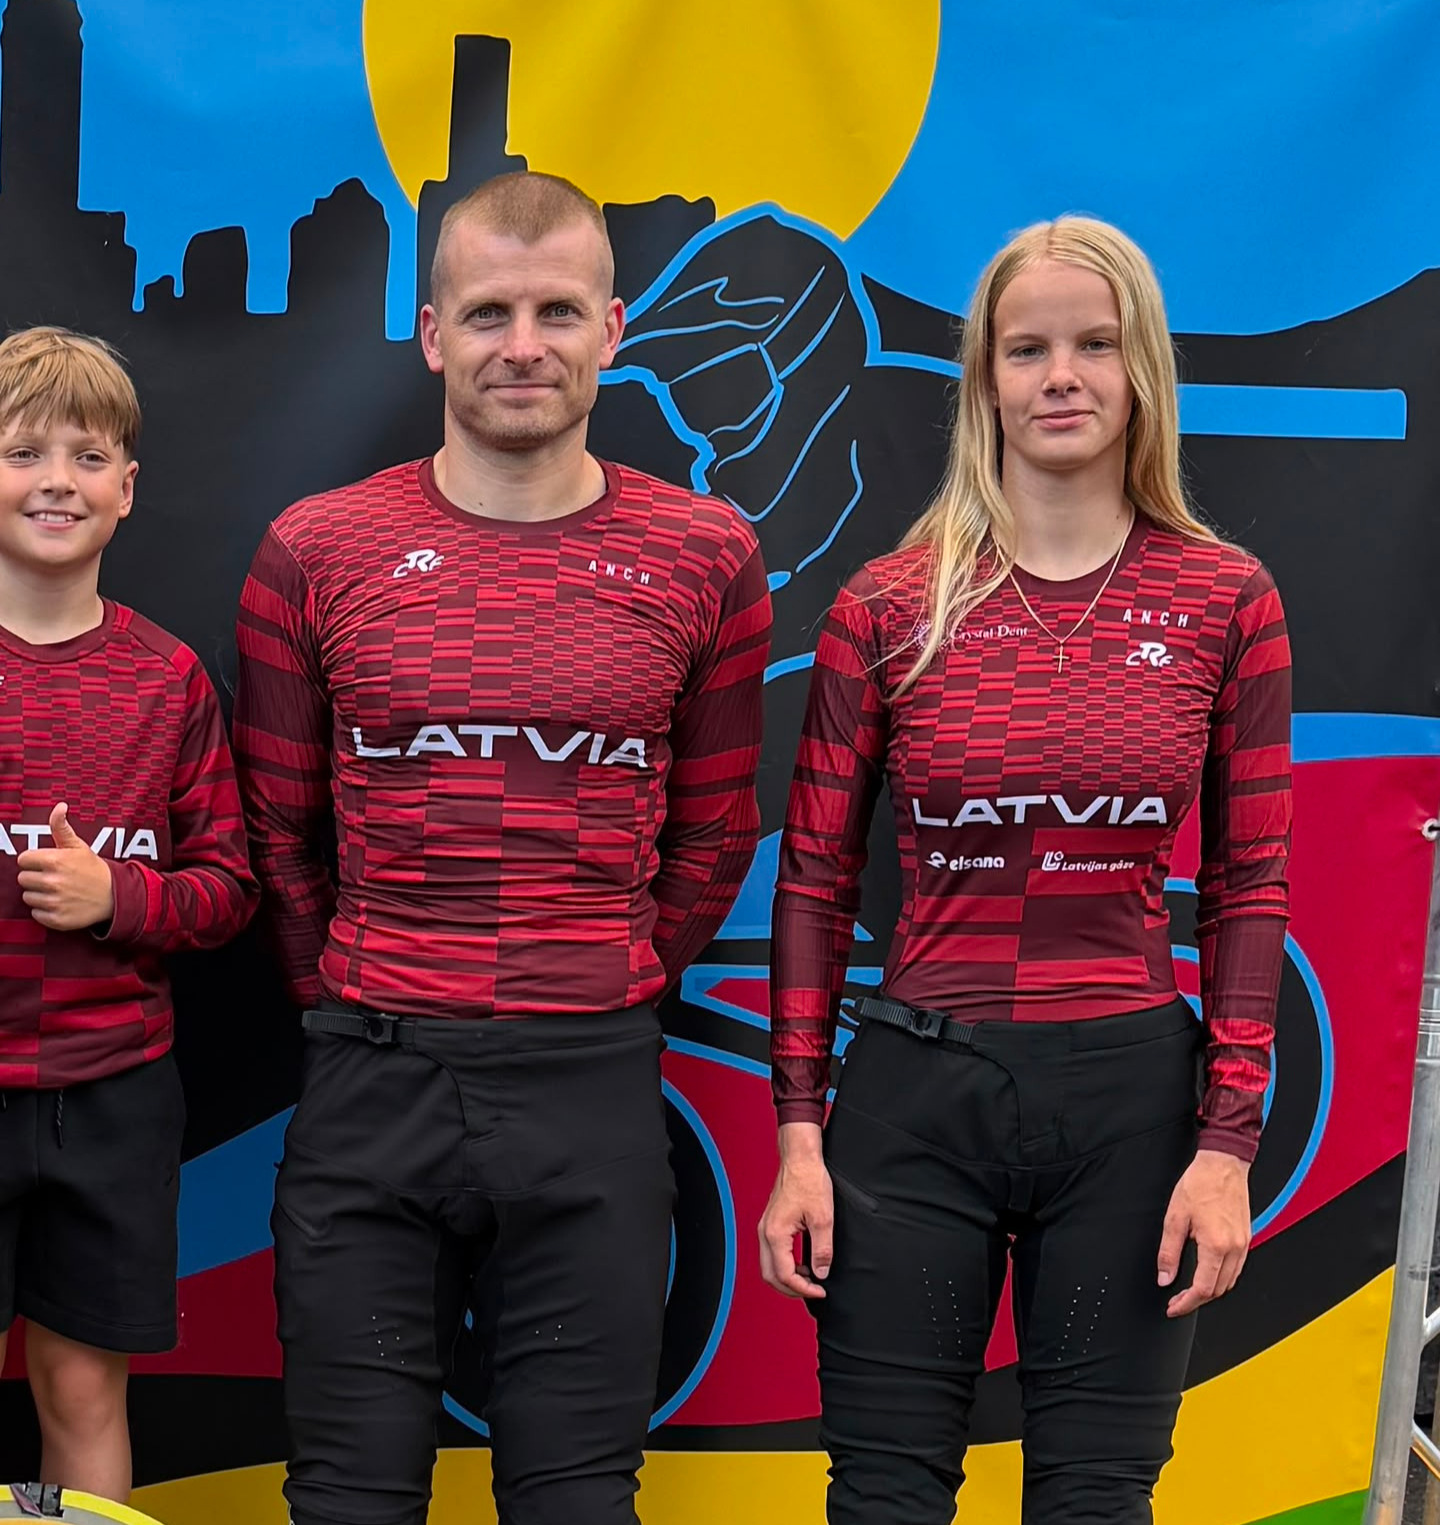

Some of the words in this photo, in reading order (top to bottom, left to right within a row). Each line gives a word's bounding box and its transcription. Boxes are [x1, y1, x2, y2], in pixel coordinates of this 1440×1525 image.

[588, 559, 651, 586] ANCH
[1122, 608, 1189, 628] ANCH
[997, 625, 1029, 638] Dent
[352, 724, 649, 768] LATVIA
[912, 794, 1168, 827] LATVIA
[949, 855, 1005, 872] elsana
[1062, 861, 1107, 873] Latvijas
